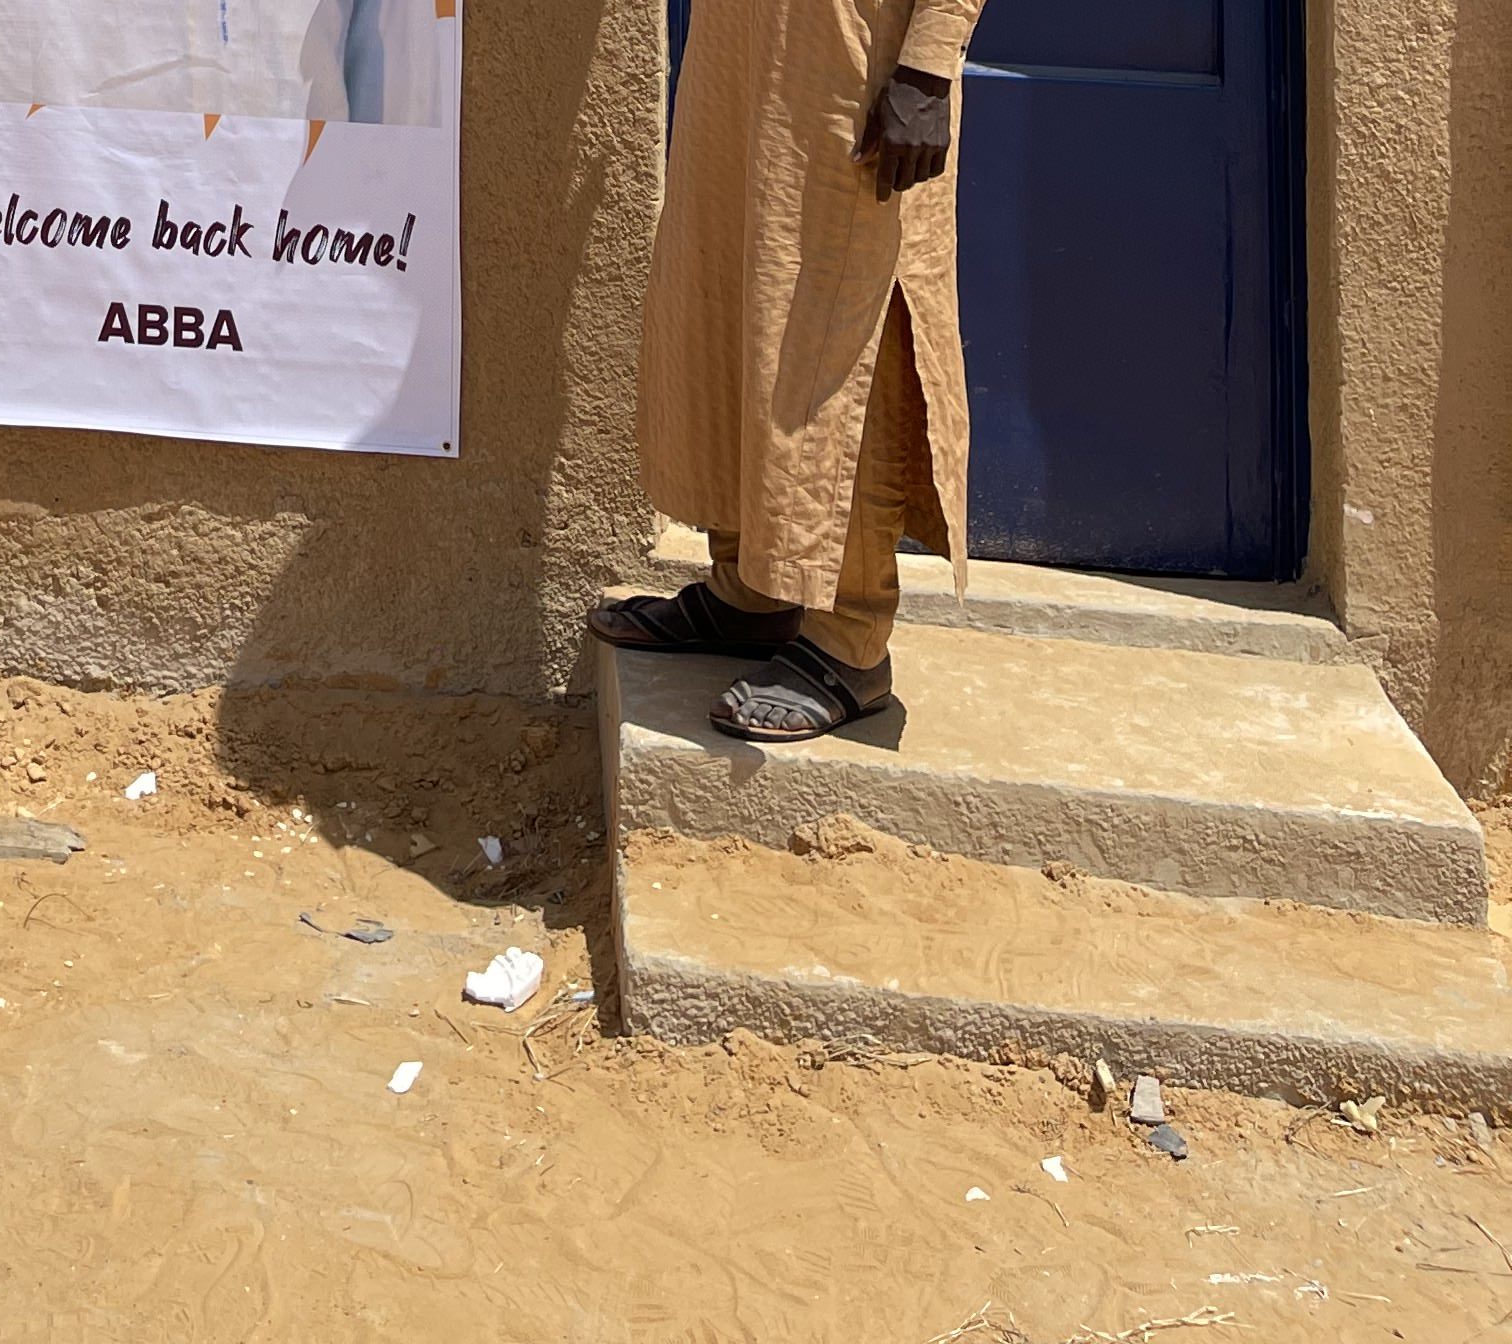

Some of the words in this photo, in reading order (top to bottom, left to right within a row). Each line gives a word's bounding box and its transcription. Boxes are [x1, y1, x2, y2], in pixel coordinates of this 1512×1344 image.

[151, 199, 255, 259] back
[272, 208, 417, 273] home!
[97, 301, 244, 352] ABBA
